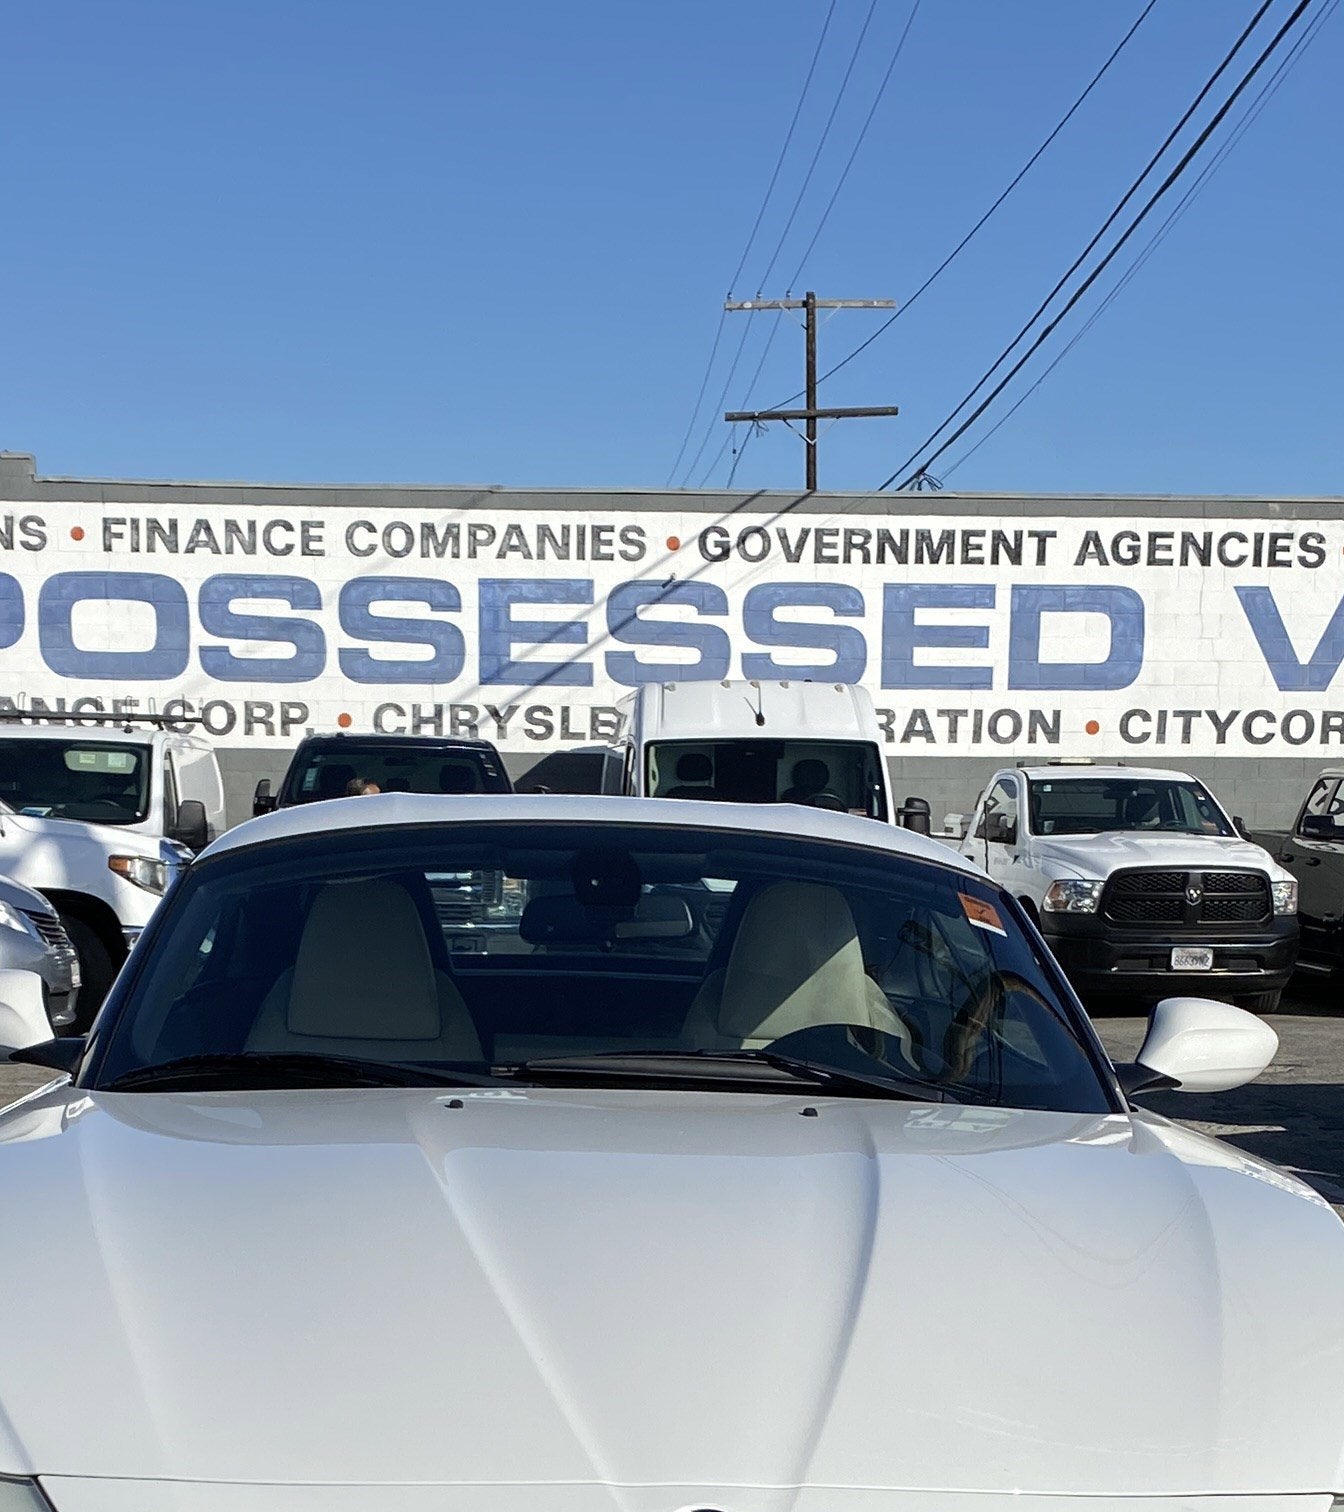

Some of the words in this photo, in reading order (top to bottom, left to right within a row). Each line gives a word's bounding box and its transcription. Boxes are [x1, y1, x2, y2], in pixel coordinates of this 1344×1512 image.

[102, 517, 326, 556] FINANCE
[345, 520, 647, 562] COMPANIES
[697, 526, 1057, 567] GOVERNMENT
[1074, 531, 1327, 569] AGENCIES
[373, 702, 618, 741] CHRYSLE
[874, 708, 1062, 745] RATION
